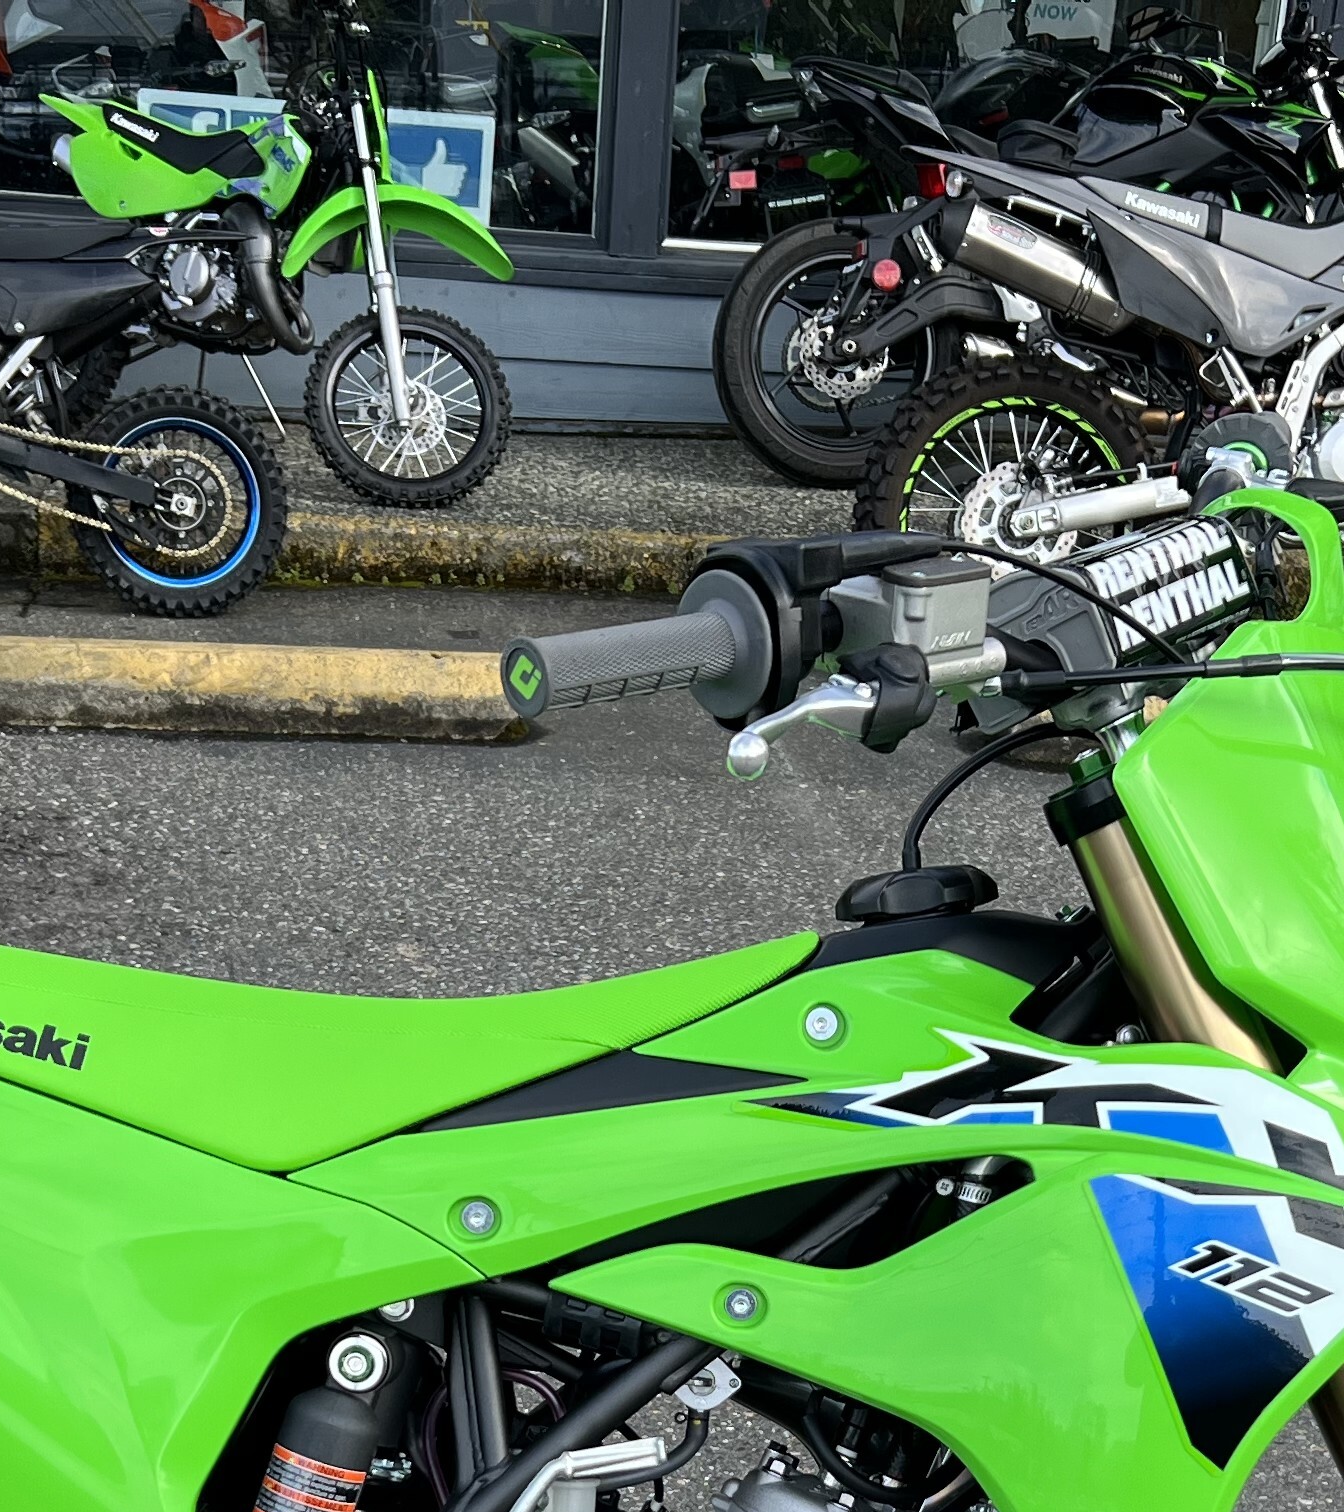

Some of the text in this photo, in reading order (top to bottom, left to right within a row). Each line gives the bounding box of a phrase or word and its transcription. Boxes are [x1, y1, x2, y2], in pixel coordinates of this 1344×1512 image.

[1034, 4, 1078, 21] NOW
[1134, 64, 1183, 84] Kawasaki
[1124, 191, 1201, 229] Kawasaki
[1084, 520, 1233, 600] RENTHAL
[1113, 558, 1251, 651] RENTHAL
[1167, 1240, 1335, 1317] 112
